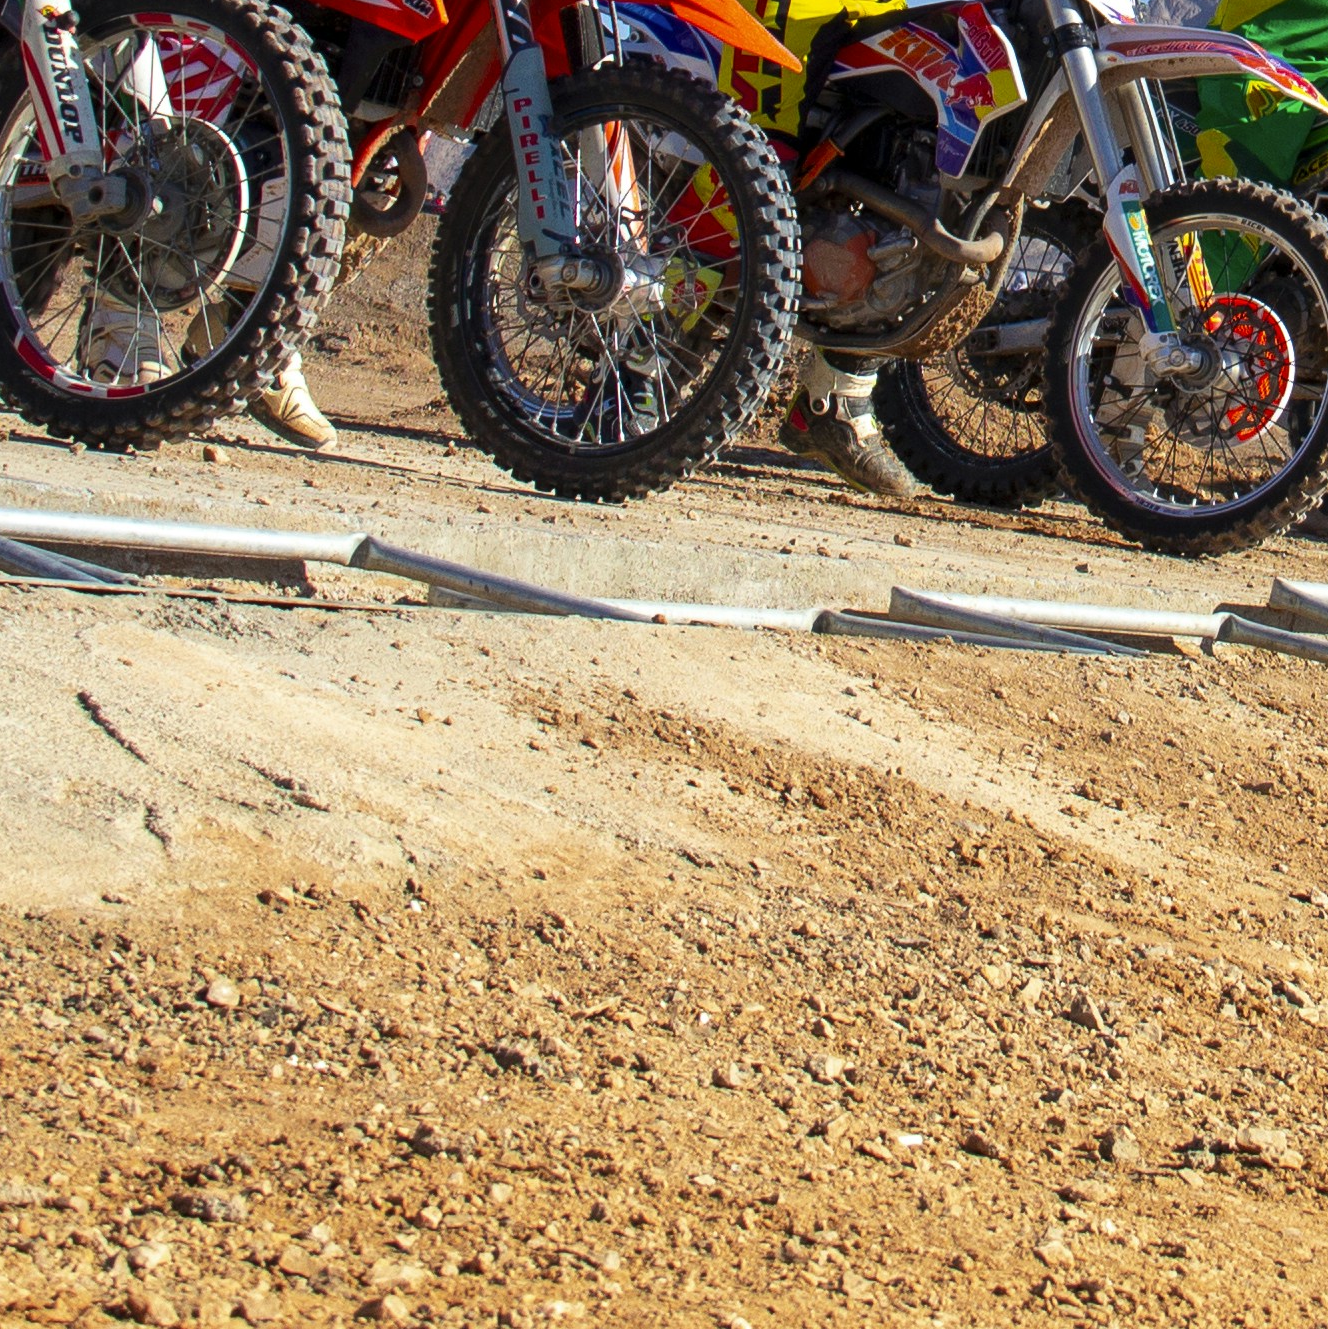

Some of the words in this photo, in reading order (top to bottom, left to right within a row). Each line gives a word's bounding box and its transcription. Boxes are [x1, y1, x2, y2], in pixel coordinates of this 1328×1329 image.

[43, 23, 84, 144] DUNLOP
[514, 97, 547, 220] PIRELLI
[1133, 231, 1165, 306] MOTOREX
